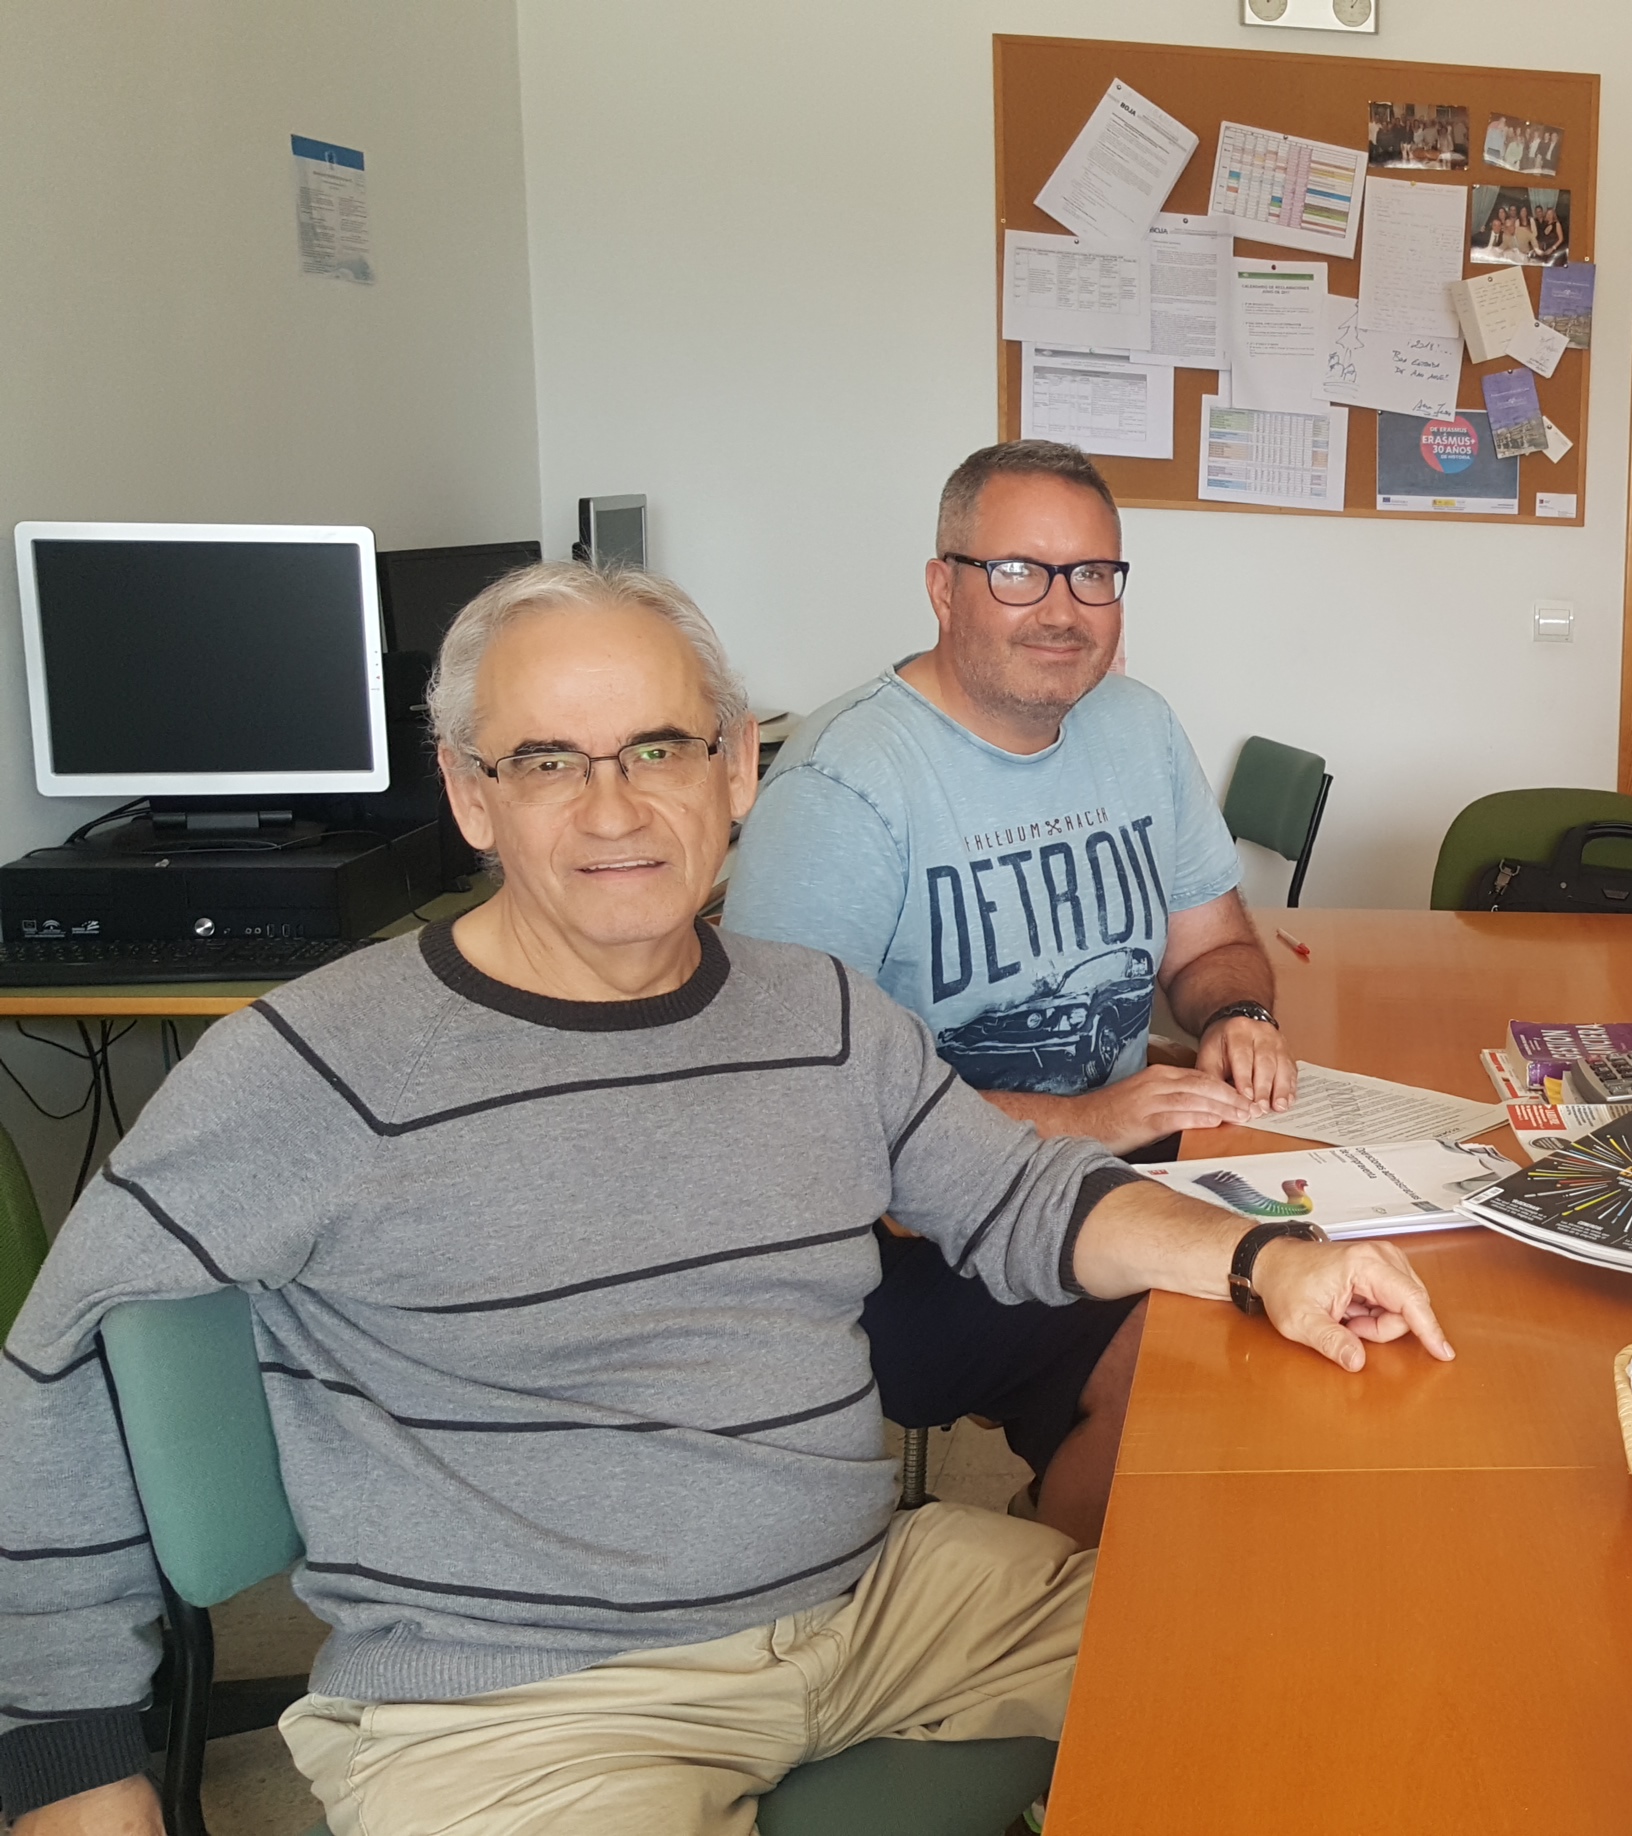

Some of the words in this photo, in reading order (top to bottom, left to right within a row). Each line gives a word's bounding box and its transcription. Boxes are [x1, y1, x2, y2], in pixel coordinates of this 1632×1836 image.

[1120, 102, 1136, 116] BOJA
[1422, 436, 1476, 446] ERASMUS+
[1432, 445, 1444, 454] 30
[1446, 444, 1472, 454] AÑOS
[964, 822, 1041, 852] FREEDOM
[1064, 806, 1110, 830] RACER
[926, 816, 1169, 1004] DETROIT
